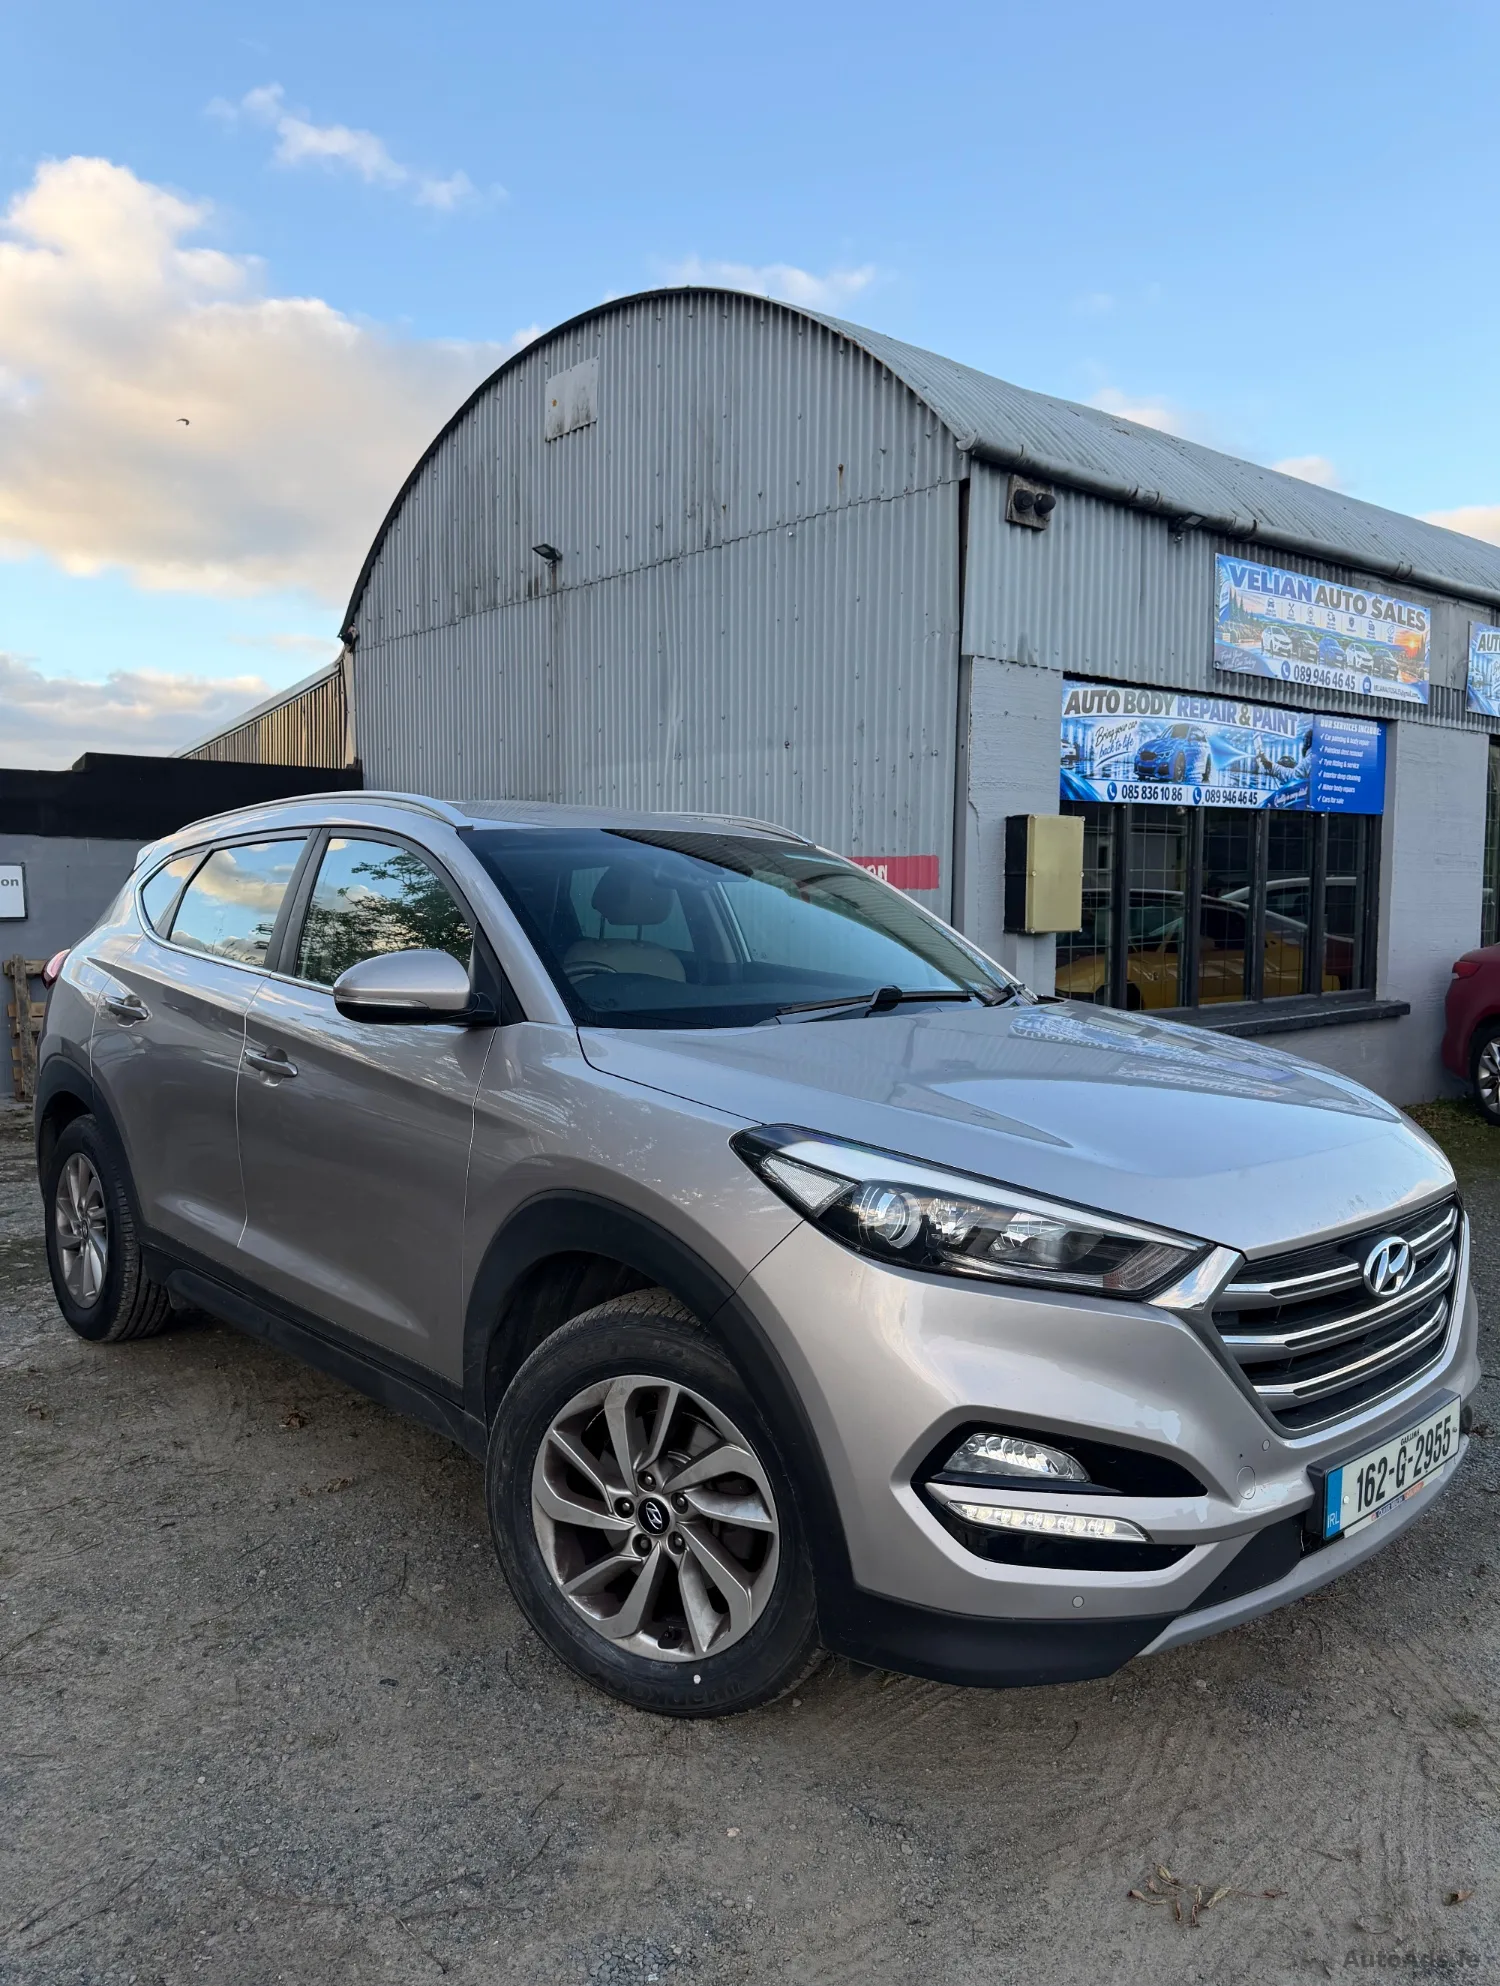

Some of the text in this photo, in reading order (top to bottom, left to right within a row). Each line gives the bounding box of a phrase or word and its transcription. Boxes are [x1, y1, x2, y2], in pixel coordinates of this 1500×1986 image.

[1228, 564, 1426, 632] VELIAN AUTO SALES
[1477, 633, 1500, 652] AUT
[1313, 668, 1331, 687] 946
[1332, 672, 1343, 689] 46
[1345, 675, 1356, 691] 45
[1064, 689, 1298, 737] AUTO BODY REPAIR & PAINT
[1095, 720, 1138, 747] Bring your car
[1320, 719, 1333, 729] OUR
[1333, 721, 1357, 733] SERVICES
[1099, 741, 1115, 759] back
[1122, 733, 1134, 751] life
[1121, 784, 1183, 802] 085 836 10 86
[1205, 788, 1258, 805] 089 946 46 45
[1356, 1414, 1452, 1513] 162-G-2955
[1327, 1511, 1340, 1529] IRL
